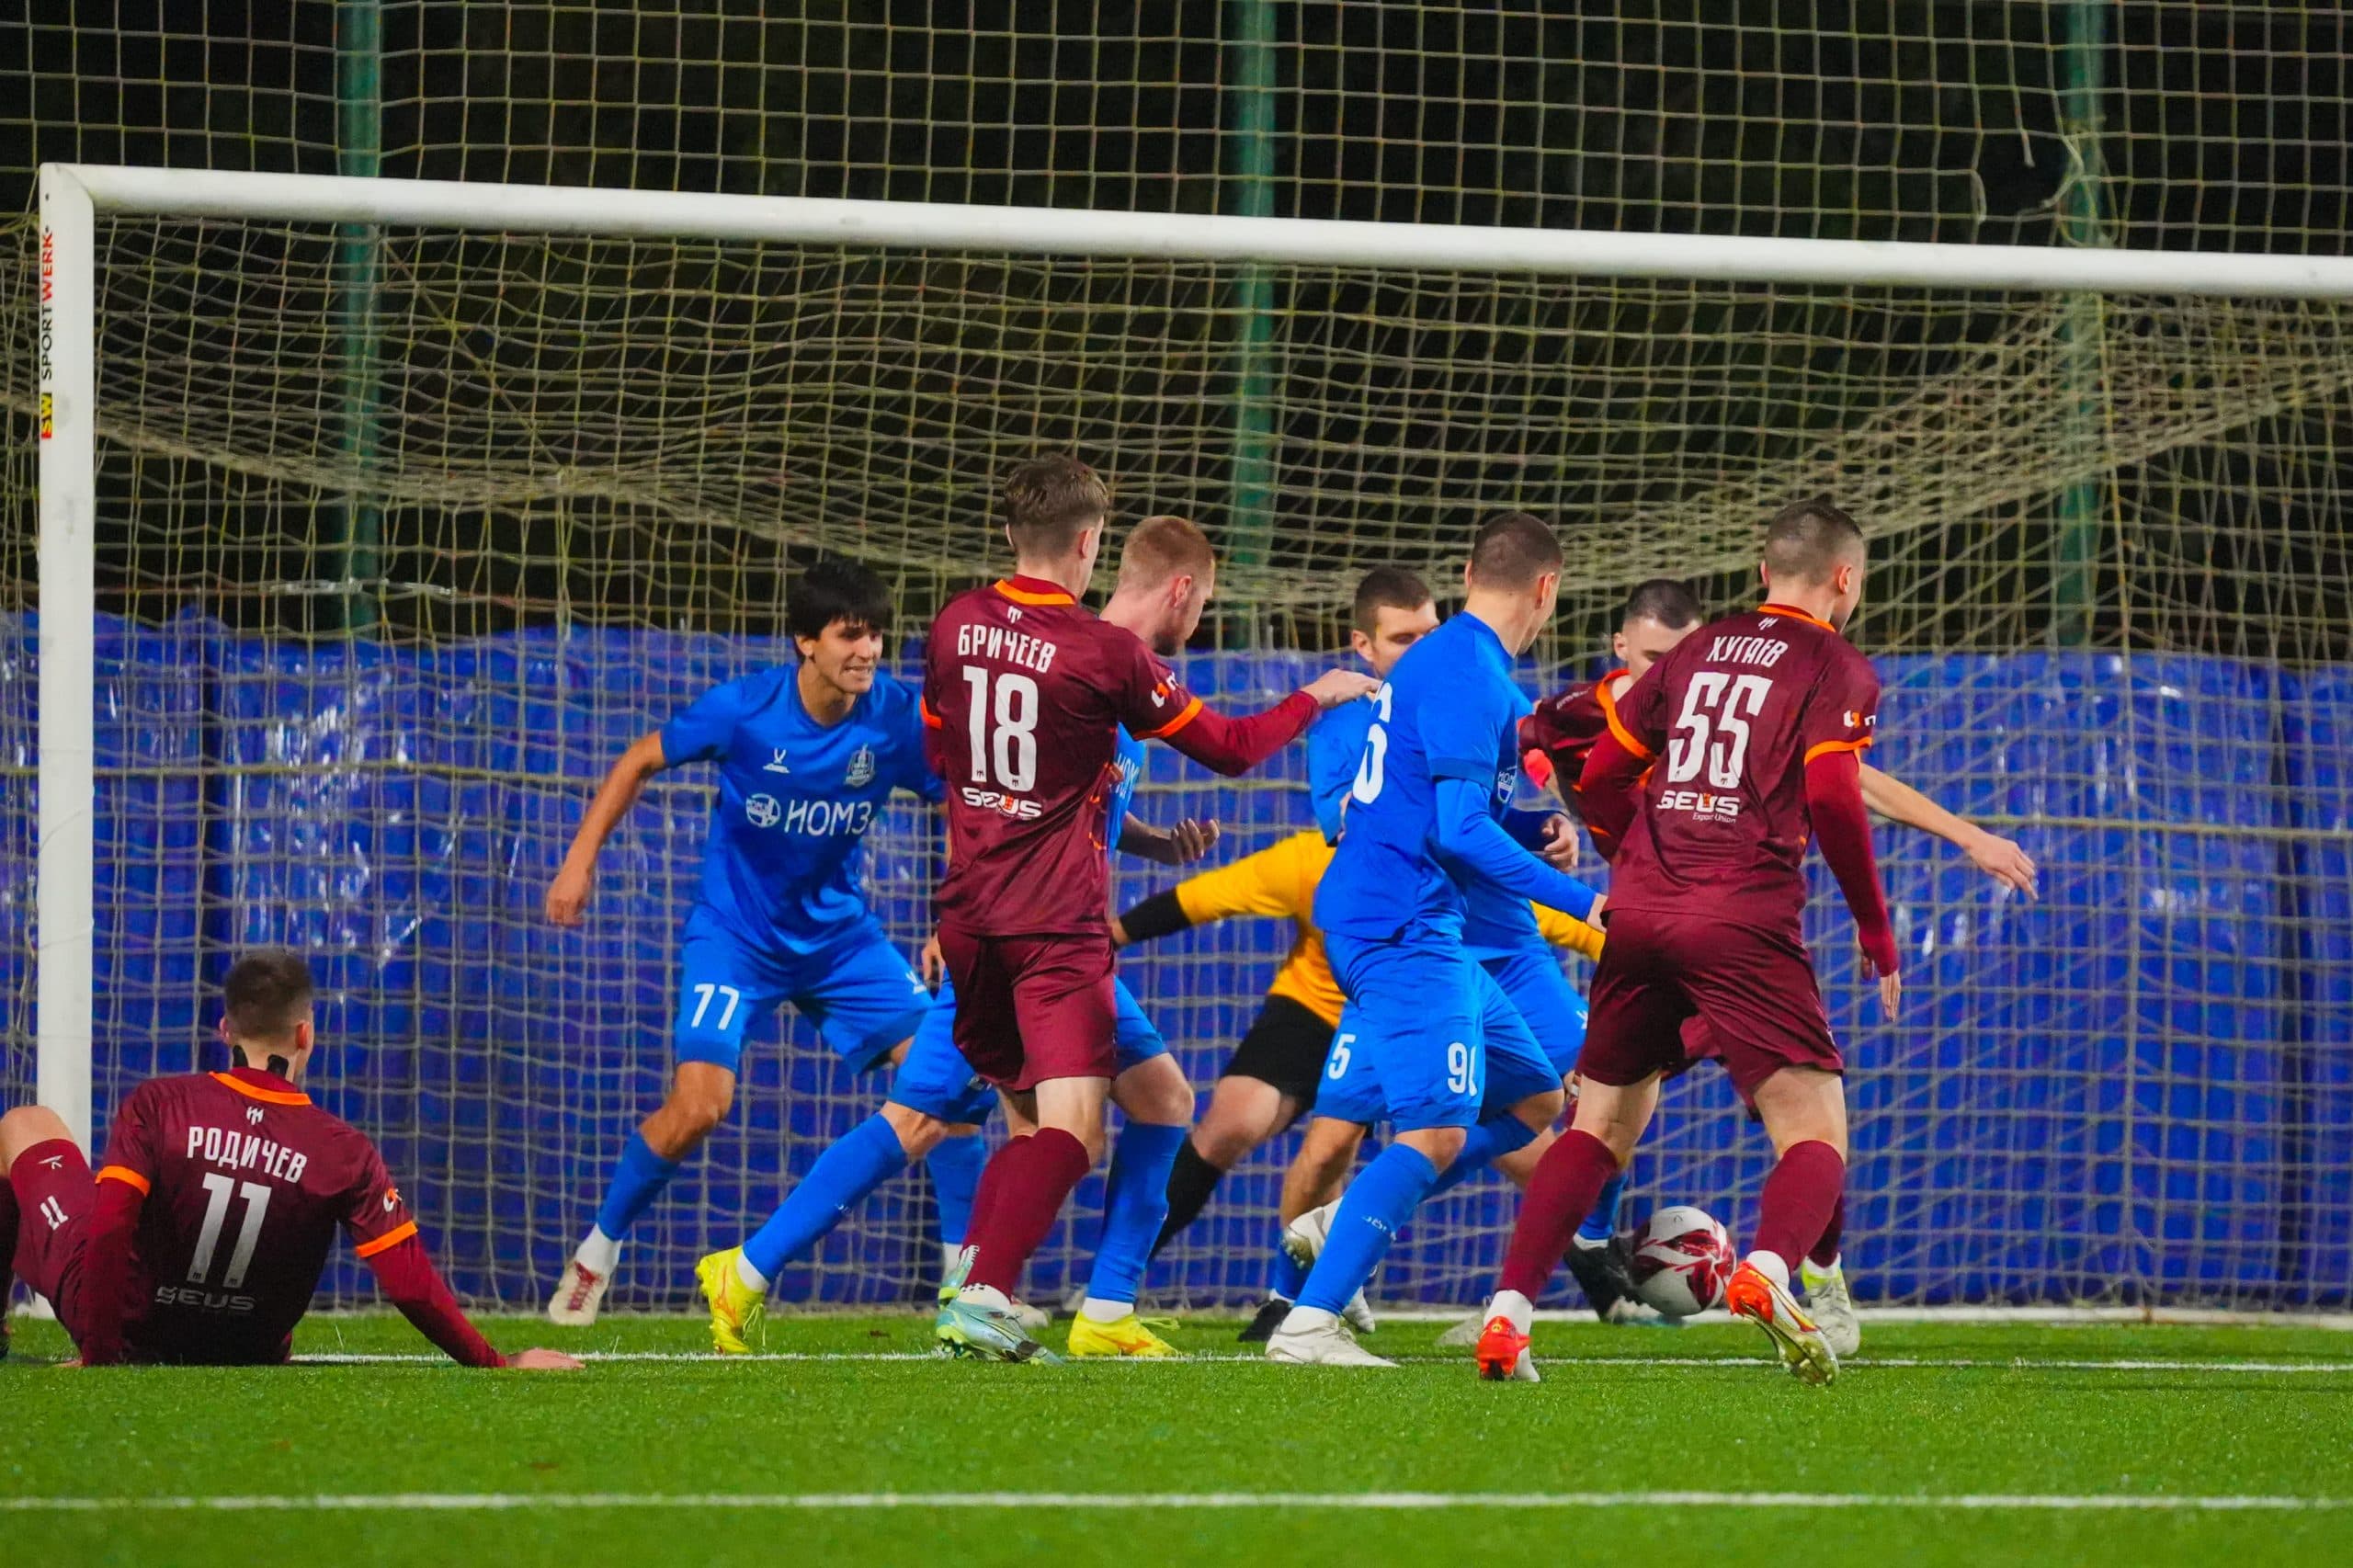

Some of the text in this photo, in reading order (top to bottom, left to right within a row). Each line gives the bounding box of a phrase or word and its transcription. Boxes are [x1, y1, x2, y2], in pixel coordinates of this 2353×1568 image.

[41, 232, 53, 381] SPORTWERK
[958, 624, 1057, 674] БРИЧЕЕВ
[962, 665, 1039, 792] 18
[1667, 672, 1773, 790] 55
[784, 799, 872, 837] НОМЗ
[961, 787, 1042, 818] SEUS
[1656, 790, 1741, 817] SEUS
[690, 983, 740, 1030] 77
[1328, 1033, 1357, 1080] 5
[188, 1126, 308, 1184] РОДИЧЕВ
[187, 1172, 272, 1289] 11
[154, 1287, 256, 1311] SEUS
